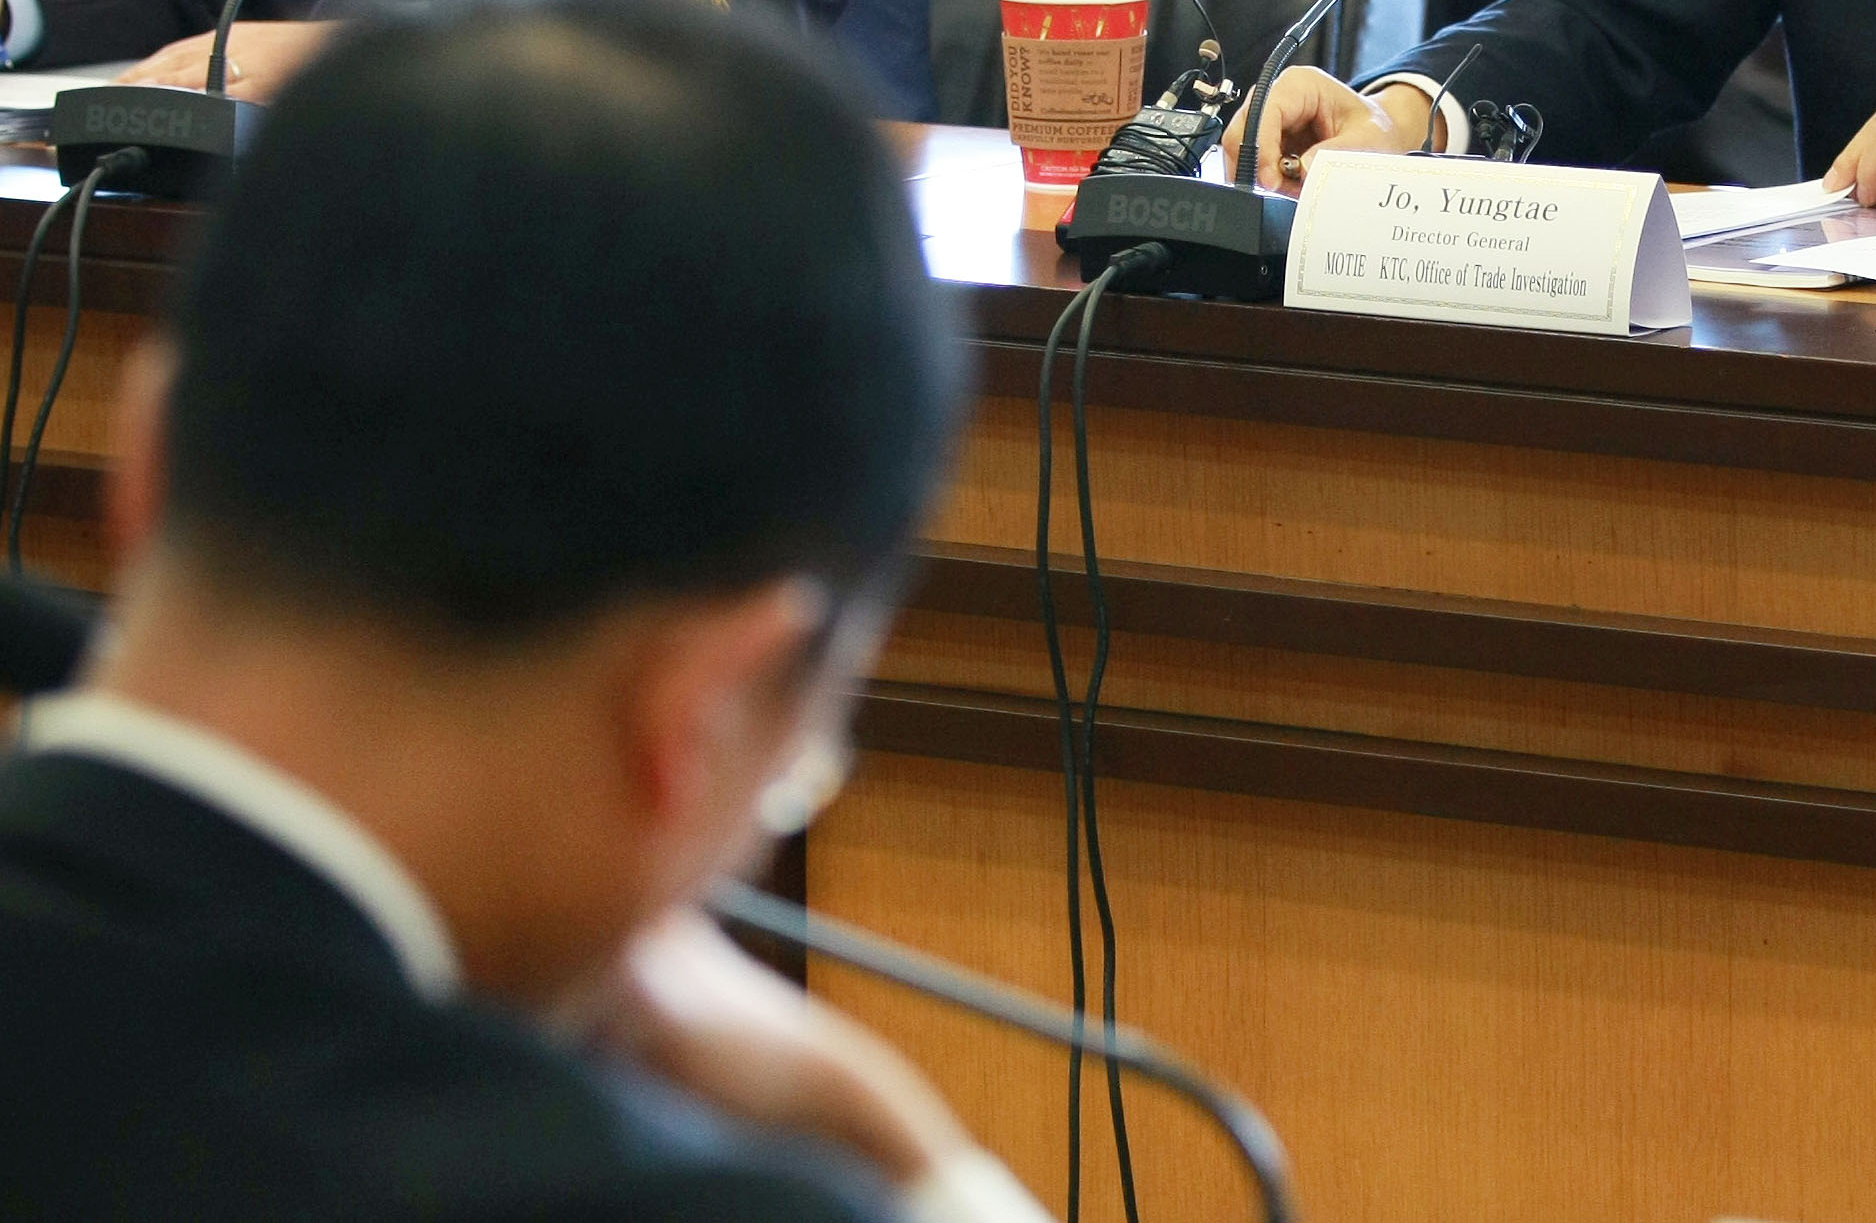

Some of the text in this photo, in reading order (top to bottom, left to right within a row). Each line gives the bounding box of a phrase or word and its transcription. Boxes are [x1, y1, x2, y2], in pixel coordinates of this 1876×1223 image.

[1008, 46, 1020, 112] DID YOU
[1020, 47, 1032, 112] KNOW?
[85, 104, 193, 138] BOSCH
[1012, 122, 1062, 136] PREMIUM
[1107, 193, 1219, 233] BOSCH
[1378, 183, 1559, 222] Jo, Yungtae
[1391, 225, 1530, 252] Director General
[1324, 250, 1587, 298] MOTIE KTC, Office of Trade Investigation
